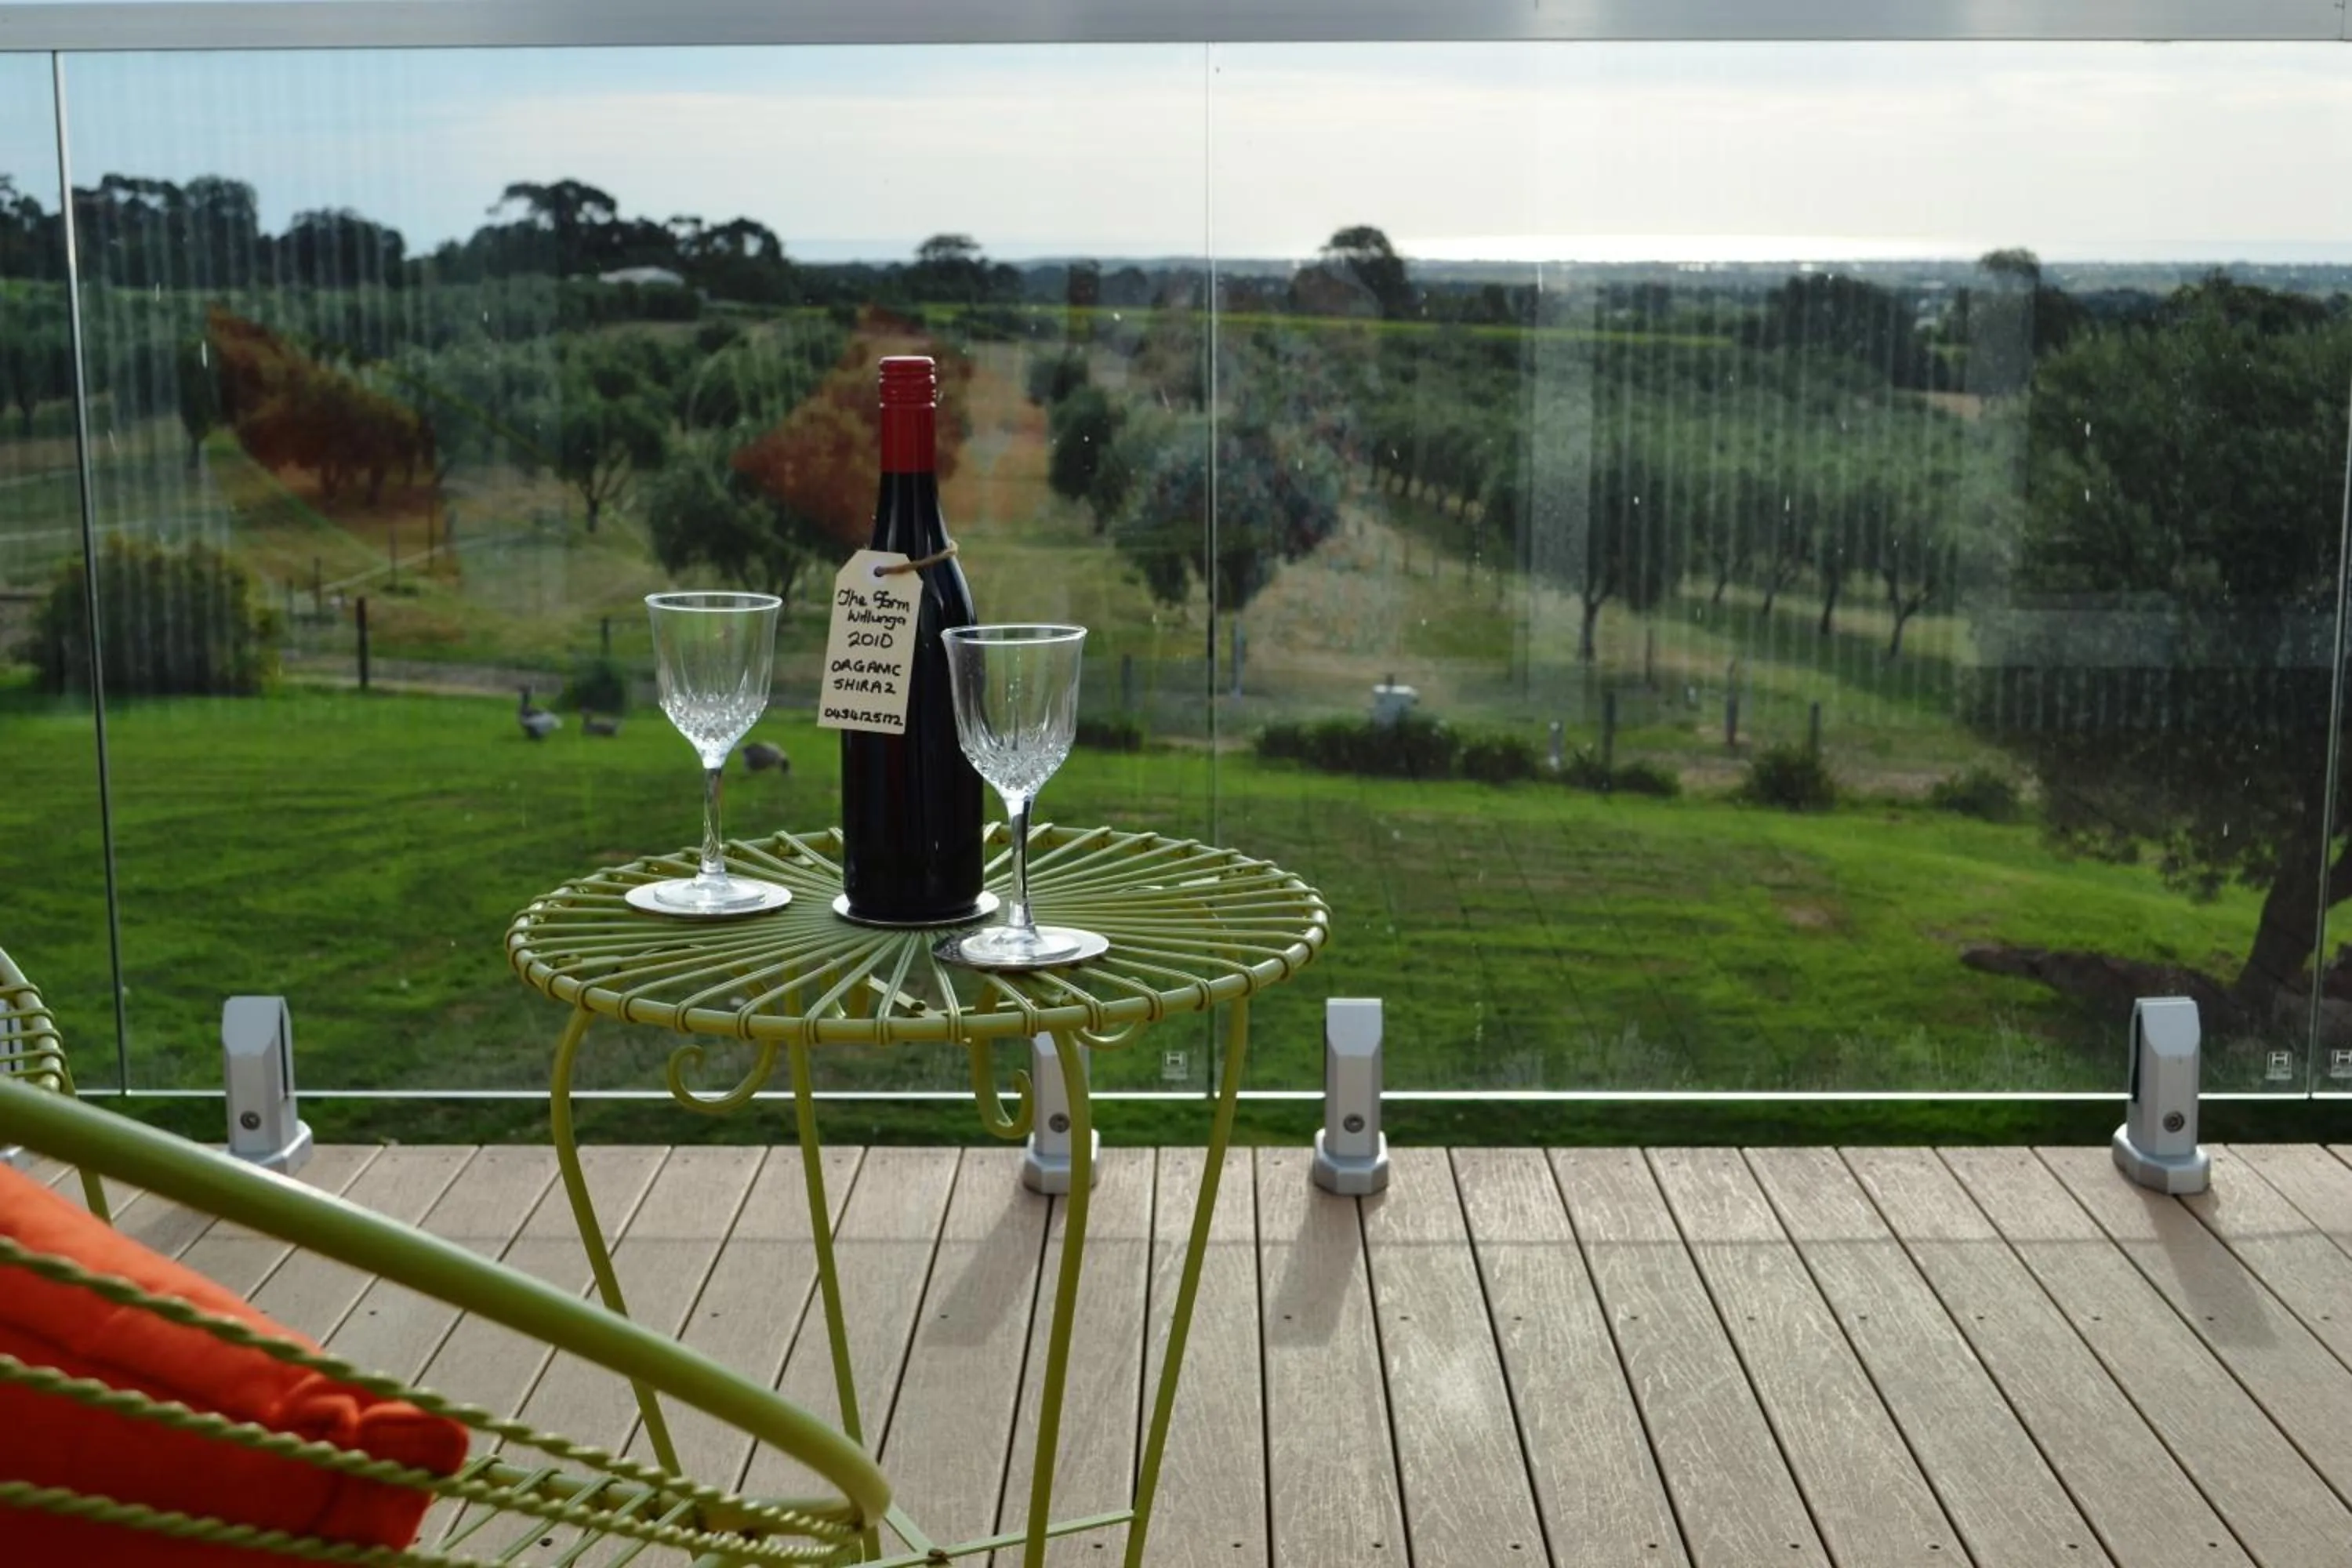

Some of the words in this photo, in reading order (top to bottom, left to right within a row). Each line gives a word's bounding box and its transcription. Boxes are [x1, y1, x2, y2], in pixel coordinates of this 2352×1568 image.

[838, 589, 867, 607] The
[873, 590, 909, 612] Farm
[848, 630, 893, 648] 2010
[831, 659, 902, 676] ORGANIC
[833, 677, 896, 694] SHIRAZ
